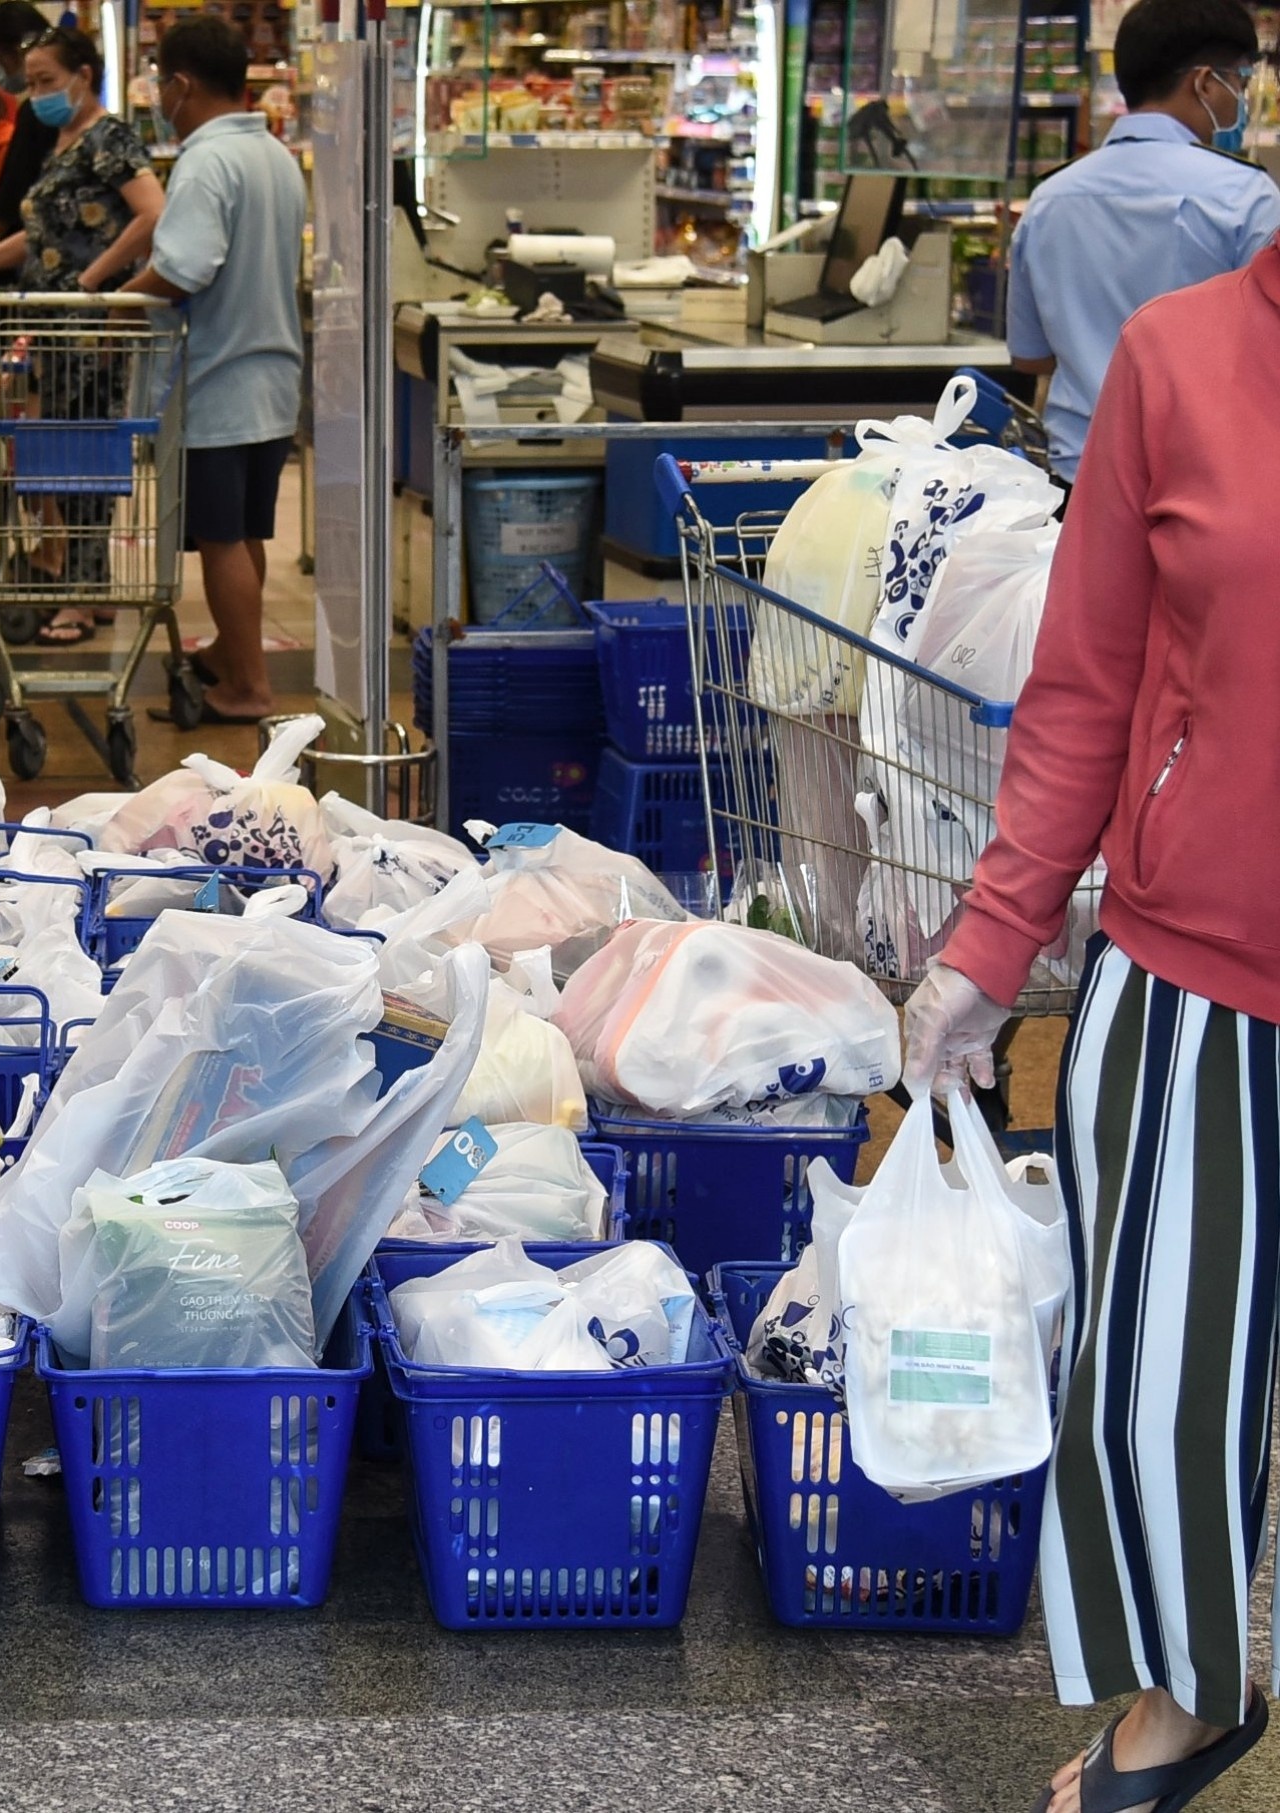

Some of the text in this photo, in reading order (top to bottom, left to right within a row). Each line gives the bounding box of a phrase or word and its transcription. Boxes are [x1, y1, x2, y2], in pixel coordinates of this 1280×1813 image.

[164, 1220, 200, 1230] COOP
[168, 1238, 242, 1277] Fine
[243, 1293, 255, 1304] ST
